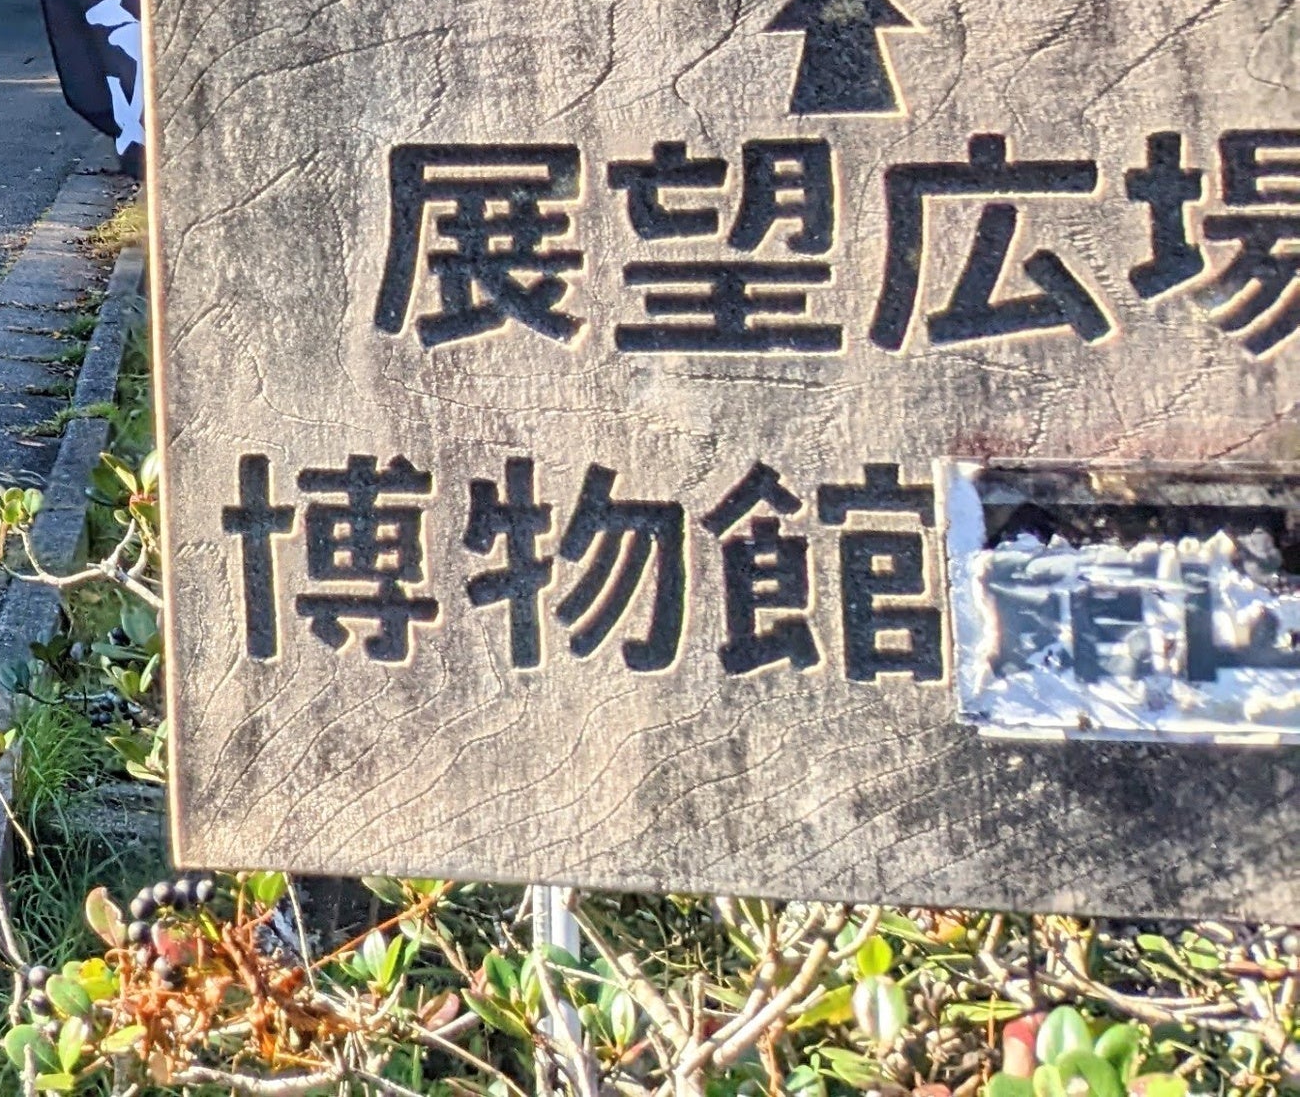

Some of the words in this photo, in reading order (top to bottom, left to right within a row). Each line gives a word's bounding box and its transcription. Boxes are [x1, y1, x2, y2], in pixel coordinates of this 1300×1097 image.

[374, 128, 1300, 357] 展望広場
[221, 452, 945, 683] 博物館
